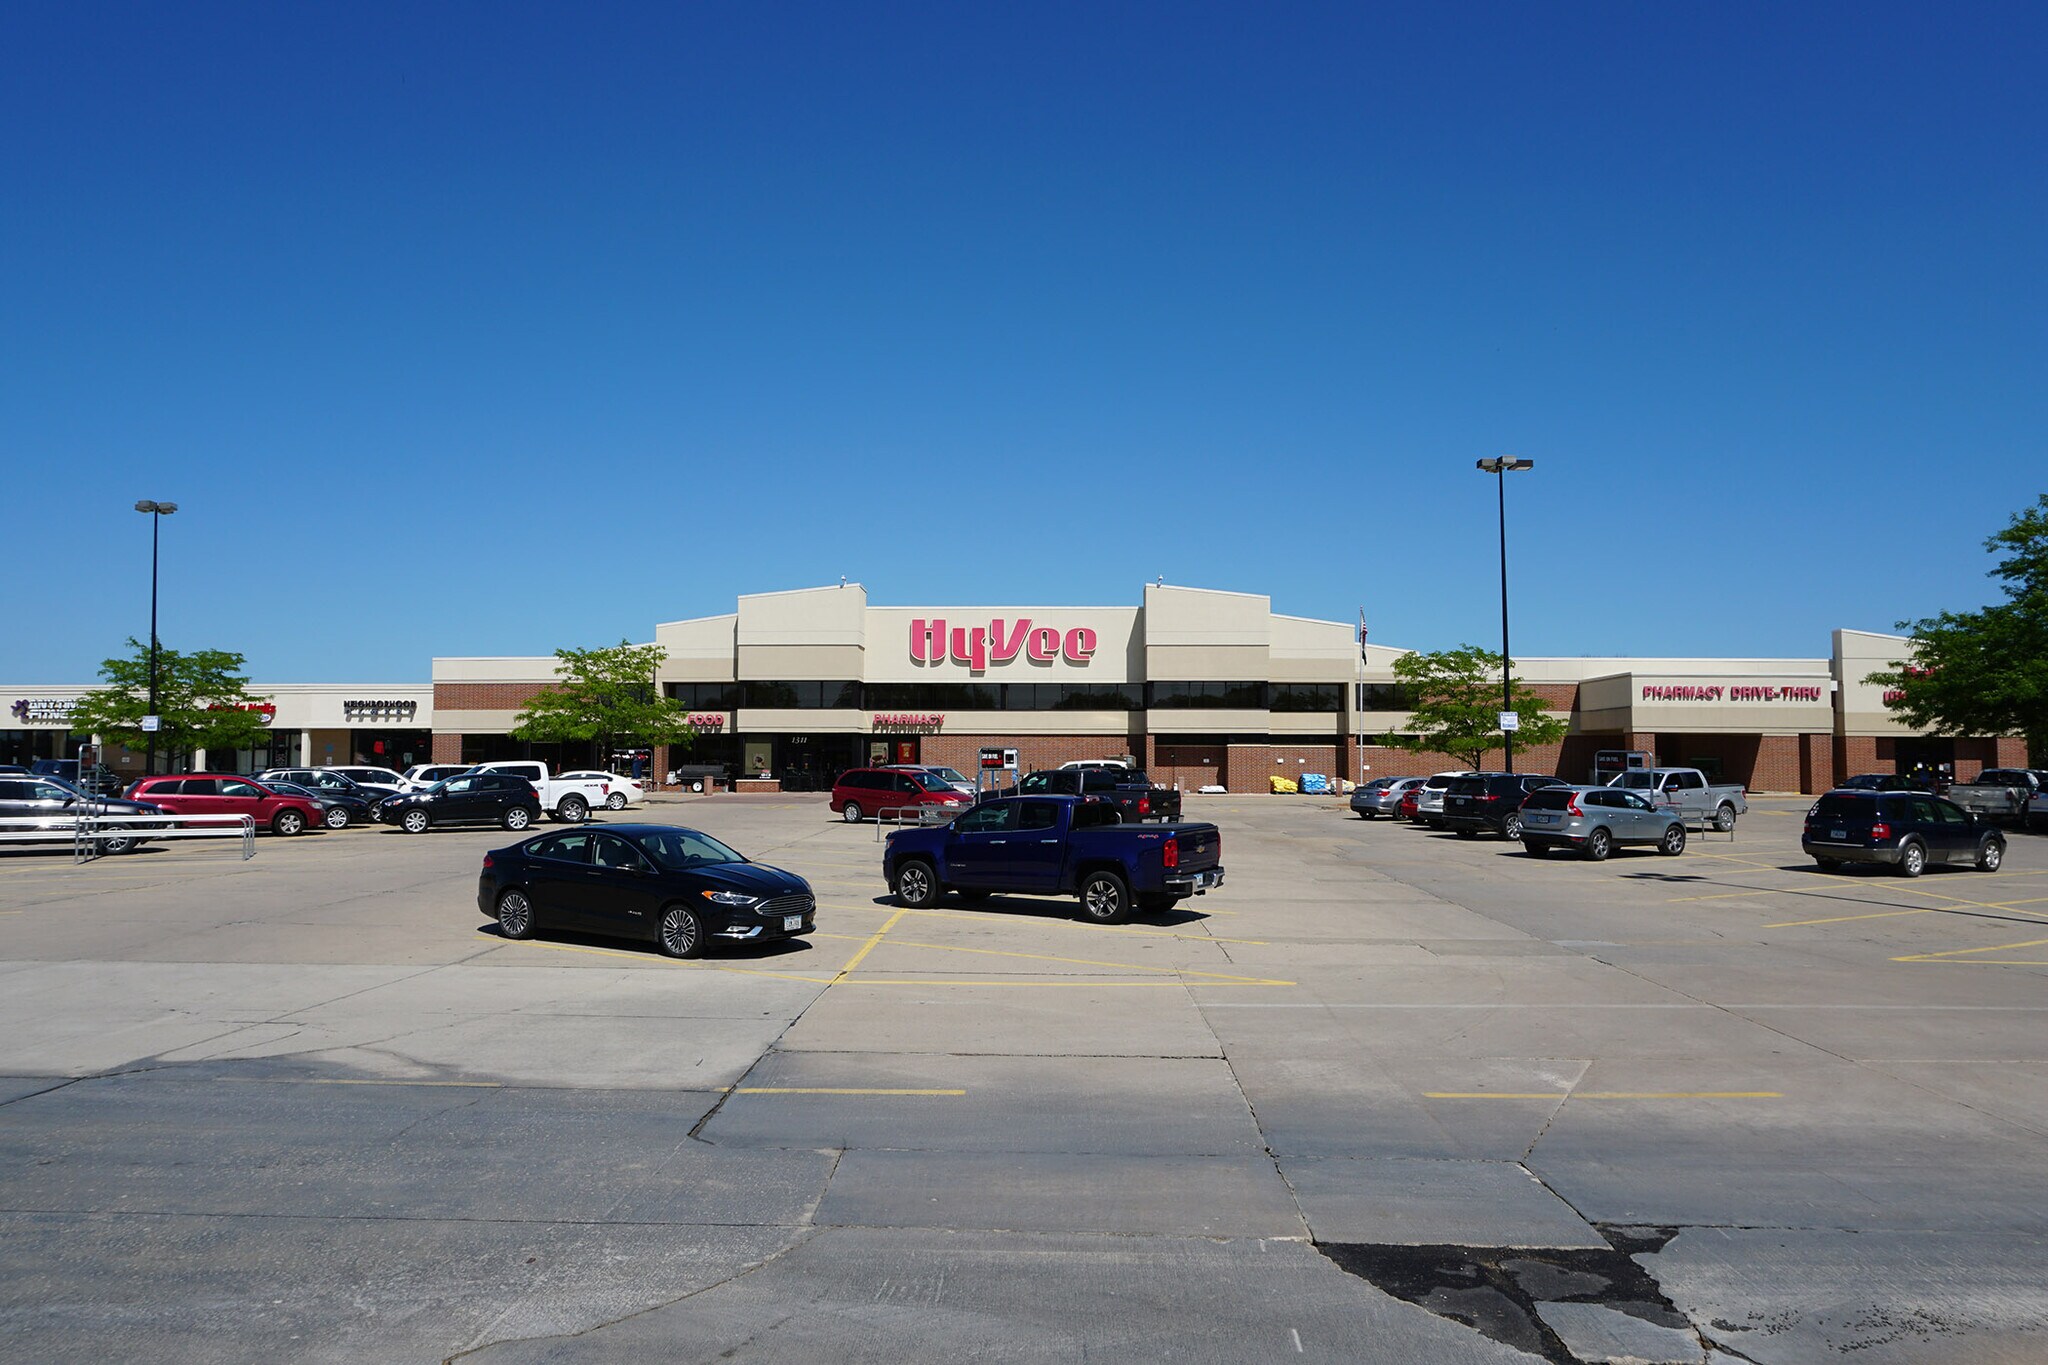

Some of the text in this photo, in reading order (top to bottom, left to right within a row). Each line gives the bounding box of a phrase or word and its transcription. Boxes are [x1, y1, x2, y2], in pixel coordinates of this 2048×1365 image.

[1643, 686, 1821, 699] PHARMACY DRIVE-THRU
[28, 699, 88, 709] ANYTIM
[343, 700, 417, 708] NEIGHBORHOOD
[687, 714, 724, 725] FOOD
[874, 714, 945, 725] PHARMACY
[791, 736, 808, 744] 1311
